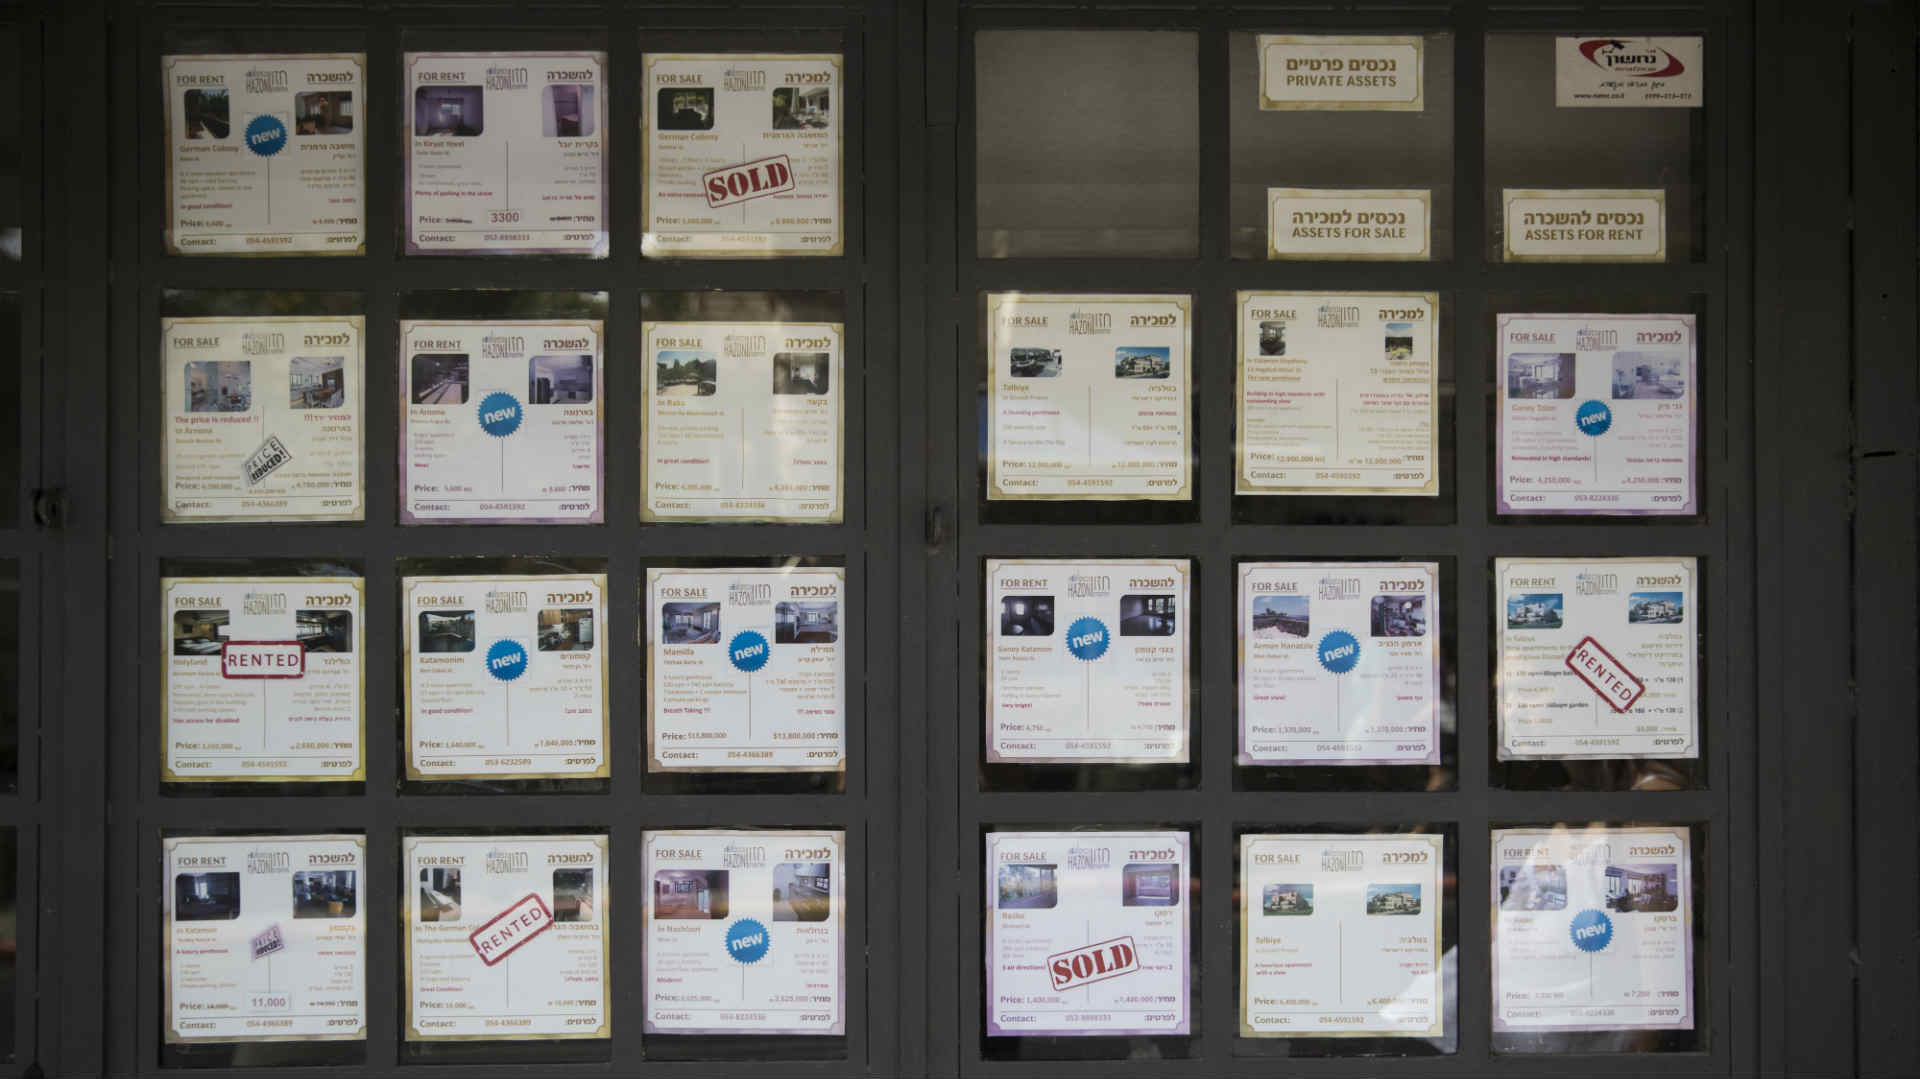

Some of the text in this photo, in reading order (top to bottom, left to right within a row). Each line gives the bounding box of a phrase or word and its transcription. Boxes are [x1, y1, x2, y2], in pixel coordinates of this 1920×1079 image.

[1286, 58, 1397, 72] נכסים פרטיים
[176, 74, 225, 84] FOR RENT
[306, 71, 354, 83] להשכרה
[417, 72, 465, 81] FOR RENT
[546, 69, 593, 80] להשכרה
[656, 73, 704, 83] FOR SALE
[784, 71, 832, 83] למכירה
[1287, 75, 1397, 87] PRIVATE ASSETS
[251, 128, 281, 145] new
[708, 161, 789, 201] SOLD
[419, 215, 443, 224] Price:
[490, 212, 520, 223] 3300
[656, 215, 681, 225] Price:
[1292, 209, 1406, 225] נכסים למכירה
[1523, 210, 1645, 226] נכסים להשכרה
[418, 234, 456, 243] Contact:
[1292, 227, 1407, 239] ASSETS FOR SALE
[1524, 229, 1644, 241] ASSETS FOR RENT
[180, 237, 217, 247] Contact:
[1250, 309, 1297, 320] FOR SALE
[1378, 307, 1425, 320] למכירה
[1024, 315, 1049, 326] SALE
[1130, 314, 1177, 326] למכירה
[173, 337, 220, 347] FOR SALE
[303, 334, 351, 346] למכירה
[655, 337, 703, 348] FOR SALE
[1510, 332, 1556, 343] FOR SALE
[1636, 330, 1682, 344] למכירה
[413, 340, 461, 350] FOR RENT
[543, 337, 590, 350] להשכרה
[785, 336, 832, 350] למכירה
[484, 405, 517, 425] new
[1580, 410, 1607, 427] new
[1250, 453, 1275, 463] Price:
[1002, 460, 1027, 470] Price:
[1250, 471, 1286, 481] Contact:
[1510, 475, 1533, 485] Price:
[414, 483, 440, 493] Price:
[1002, 478, 1039, 488] Contact:
[1510, 493, 1546, 503] Contact:
[414, 503, 451, 512] Contact:
[1001, 578, 1048, 588] FOR RENT
[1129, 576, 1175, 589] להשכרה
[1251, 581, 1298, 592] FOR SALE
[1379, 579, 1425, 592] למכירה
[1510, 576, 1556, 587] FOR RENT
[1636, 575, 1682, 587] להשכרה
[661, 587, 707, 598] FOR SALE
[790, 584, 837, 598] למכירה
[174, 596, 222, 607] FOR SALE
[306, 593, 352, 607] למכירה
[416, 595, 465, 606] FOR SALE
[546, 590, 594, 604] למכירה
[1072, 629, 1104, 649] new
[734, 643, 764, 661] new
[1323, 643, 1355, 662] new
[228, 653, 300, 668] RENTED
[491, 650, 522, 670] new
[1575, 648, 1634, 702] RENTED
[1001, 723, 1025, 732] Price:
[1252, 725, 1275, 735] Price:
[662, 732, 687, 742] Price:
[175, 742, 200, 751] Price:
[419, 740, 444, 750] Price:
[1001, 742, 1037, 751] Contact:
[1252, 743, 1288, 753] Contact:
[662, 751, 699, 760] Contact:
[175, 760, 213, 769] Contact:
[419, 759, 457, 768] Contact:
[655, 849, 702, 859] FOR SALE
[784, 846, 832, 860] למכירה
[1001, 851, 1048, 861] FOR SALE
[1129, 848, 1176, 861] למכירה
[1629, 844, 1675, 857] להשכרה
[178, 856, 227, 866] FOR RENT
[308, 852, 356, 865] להשכרה
[417, 855, 465, 866] FOR RENT
[547, 851, 594, 864] להשכרה
[1254, 853, 1301, 864] FOR SALE
[1382, 850, 1429, 864] למכירה
[479, 906, 544, 955] RENTED
[1575, 922, 1608, 941] new
[731, 932, 764, 951] new
[1052, 943, 1134, 985] SOLD
[419, 1000, 444, 1010] Price:
[1001, 995, 1025, 1005] Price:
[179, 1001, 204, 1011] Price:
[419, 1019, 457, 1029] Contact:
[1001, 1014, 1038, 1024] Contact:
[1254, 1015, 1292, 1025] Contact:
[179, 1020, 217, 1030] Contact:
